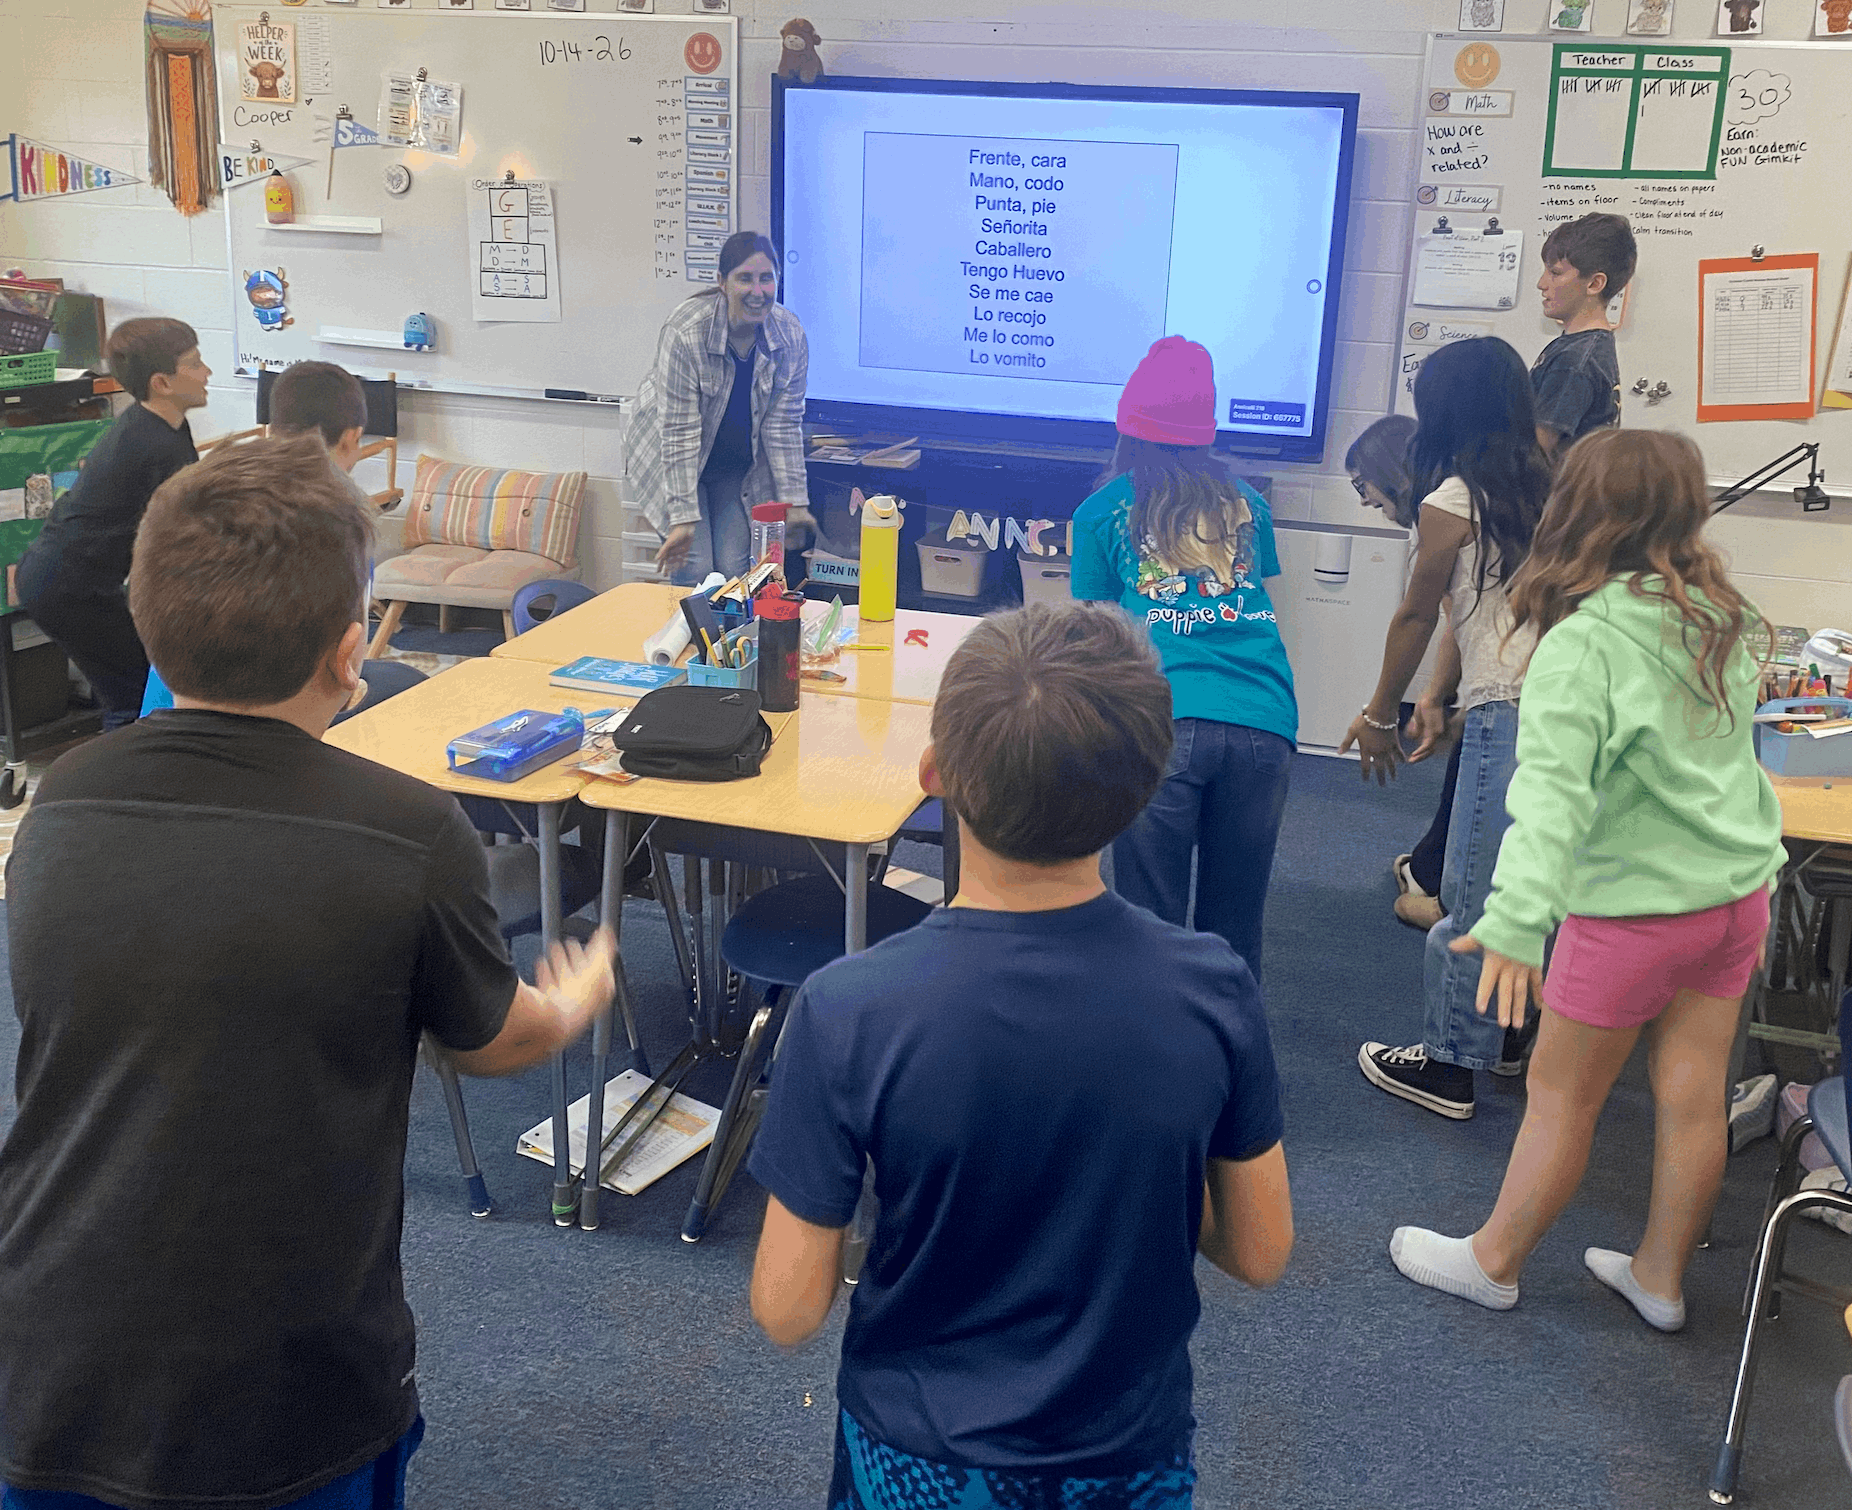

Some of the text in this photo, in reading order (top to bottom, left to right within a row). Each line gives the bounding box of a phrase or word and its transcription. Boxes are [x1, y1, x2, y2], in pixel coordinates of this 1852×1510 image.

[246, 26, 284, 41] HELPER
[248, 46, 282, 61] WEEK
[1572, 54, 1626, 66] Teacher
[1657, 56, 1694, 68] Class
[1464, 96, 1498, 112] Math
[1739, 88, 1779, 110] 30
[234, 106, 294, 126] Cooper
[1427, 124, 1484, 140] How are
[1440, 142, 1462, 155] and
[969, 148, 1067, 168] Frente, cara
[1432, 154, 1488, 172] related?
[1720, 156, 1747, 169] FUN
[20, 142, 111, 194] KINDNESS
[223, 156, 274, 182] BE KIND
[970, 172, 1064, 191] Mano, codo
[1564, 184, 1596, 192] names
[1691, 184, 1715, 194] papers
[499, 191, 514, 212] G
[975, 195, 1056, 216] Punta, pie
[1444, 188, 1493, 212] Literacy
[1594, 194, 1619, 204] floor
[1639, 198, 1684, 206] Compliments
[1544, 214, 1574, 222] Volume
[1657, 210, 1672, 218] floor
[1682, 210, 1696, 218] end
[1700, 208, 1708, 218] of
[1709, 209, 1724, 219] day
[504, 219, 512, 240] E
[981, 218, 1047, 236] Señorita
[1632, 226, 1693, 236] Calm transition
[489, 245, 529, 254] M D
[975, 240, 1052, 258] Caballero
[492, 256, 529, 266] D M
[493, 274, 530, 284] A S
[960, 261, 1064, 282] Tengo Huevo
[494, 283, 530, 293] S A
[969, 284, 1054, 303] Se me cae
[974, 306, 1046, 328] Lo recojo
[964, 326, 1054, 348] Me lo como
[970, 350, 1046, 368] Lo vomito
[1233, 411, 1261, 420] Session
[1262, 412, 1272, 420] ID:
[816, 562, 859, 578] TURN IN
[1146, 603, 1216, 635] puppie
